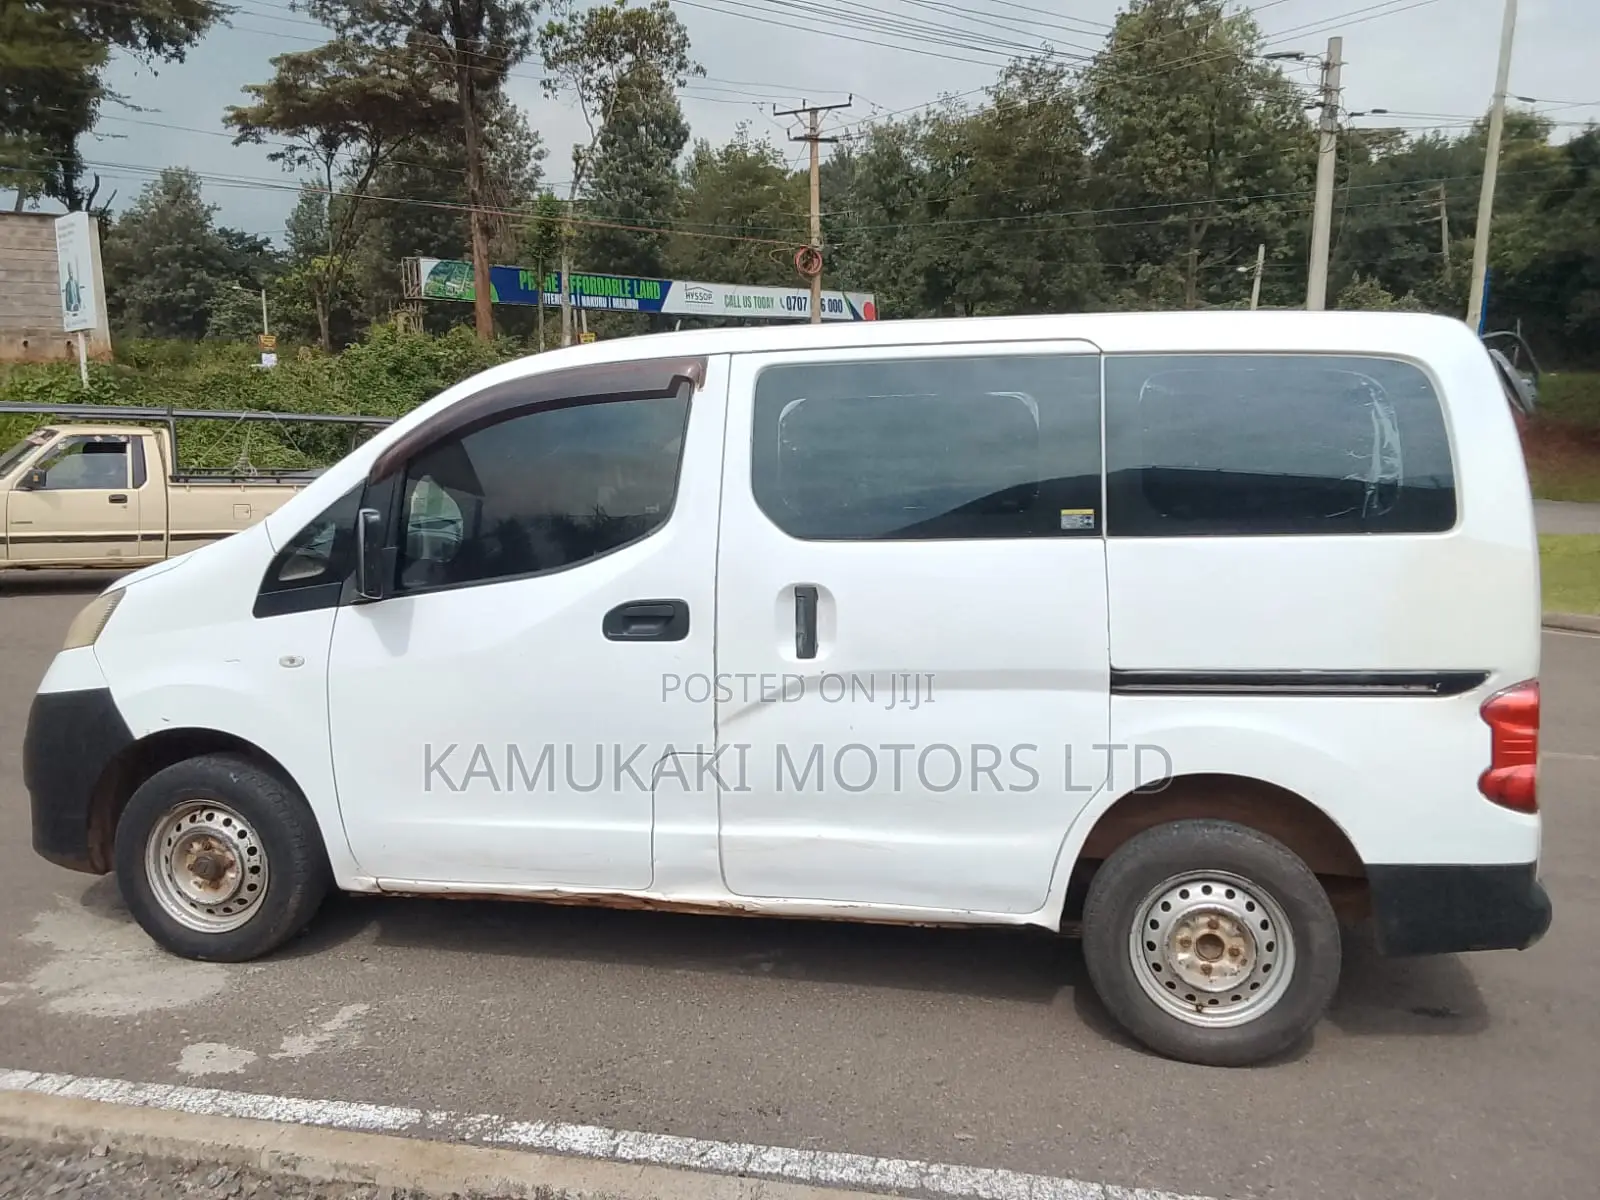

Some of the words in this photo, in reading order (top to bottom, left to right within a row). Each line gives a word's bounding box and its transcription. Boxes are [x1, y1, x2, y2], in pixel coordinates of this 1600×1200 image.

[519, 270, 559, 292] PRME
[564, 274, 632, 298] FFORDABLE
[634, 279, 661, 299] LAND
[685, 291, 713, 301] HYSSOP
[724, 294, 742, 308] CALL
[743, 295, 752, 308] US
[753, 296, 774, 309] TODAY
[786, 295, 808, 311] 0707
[827, 298, 843, 313] 000
